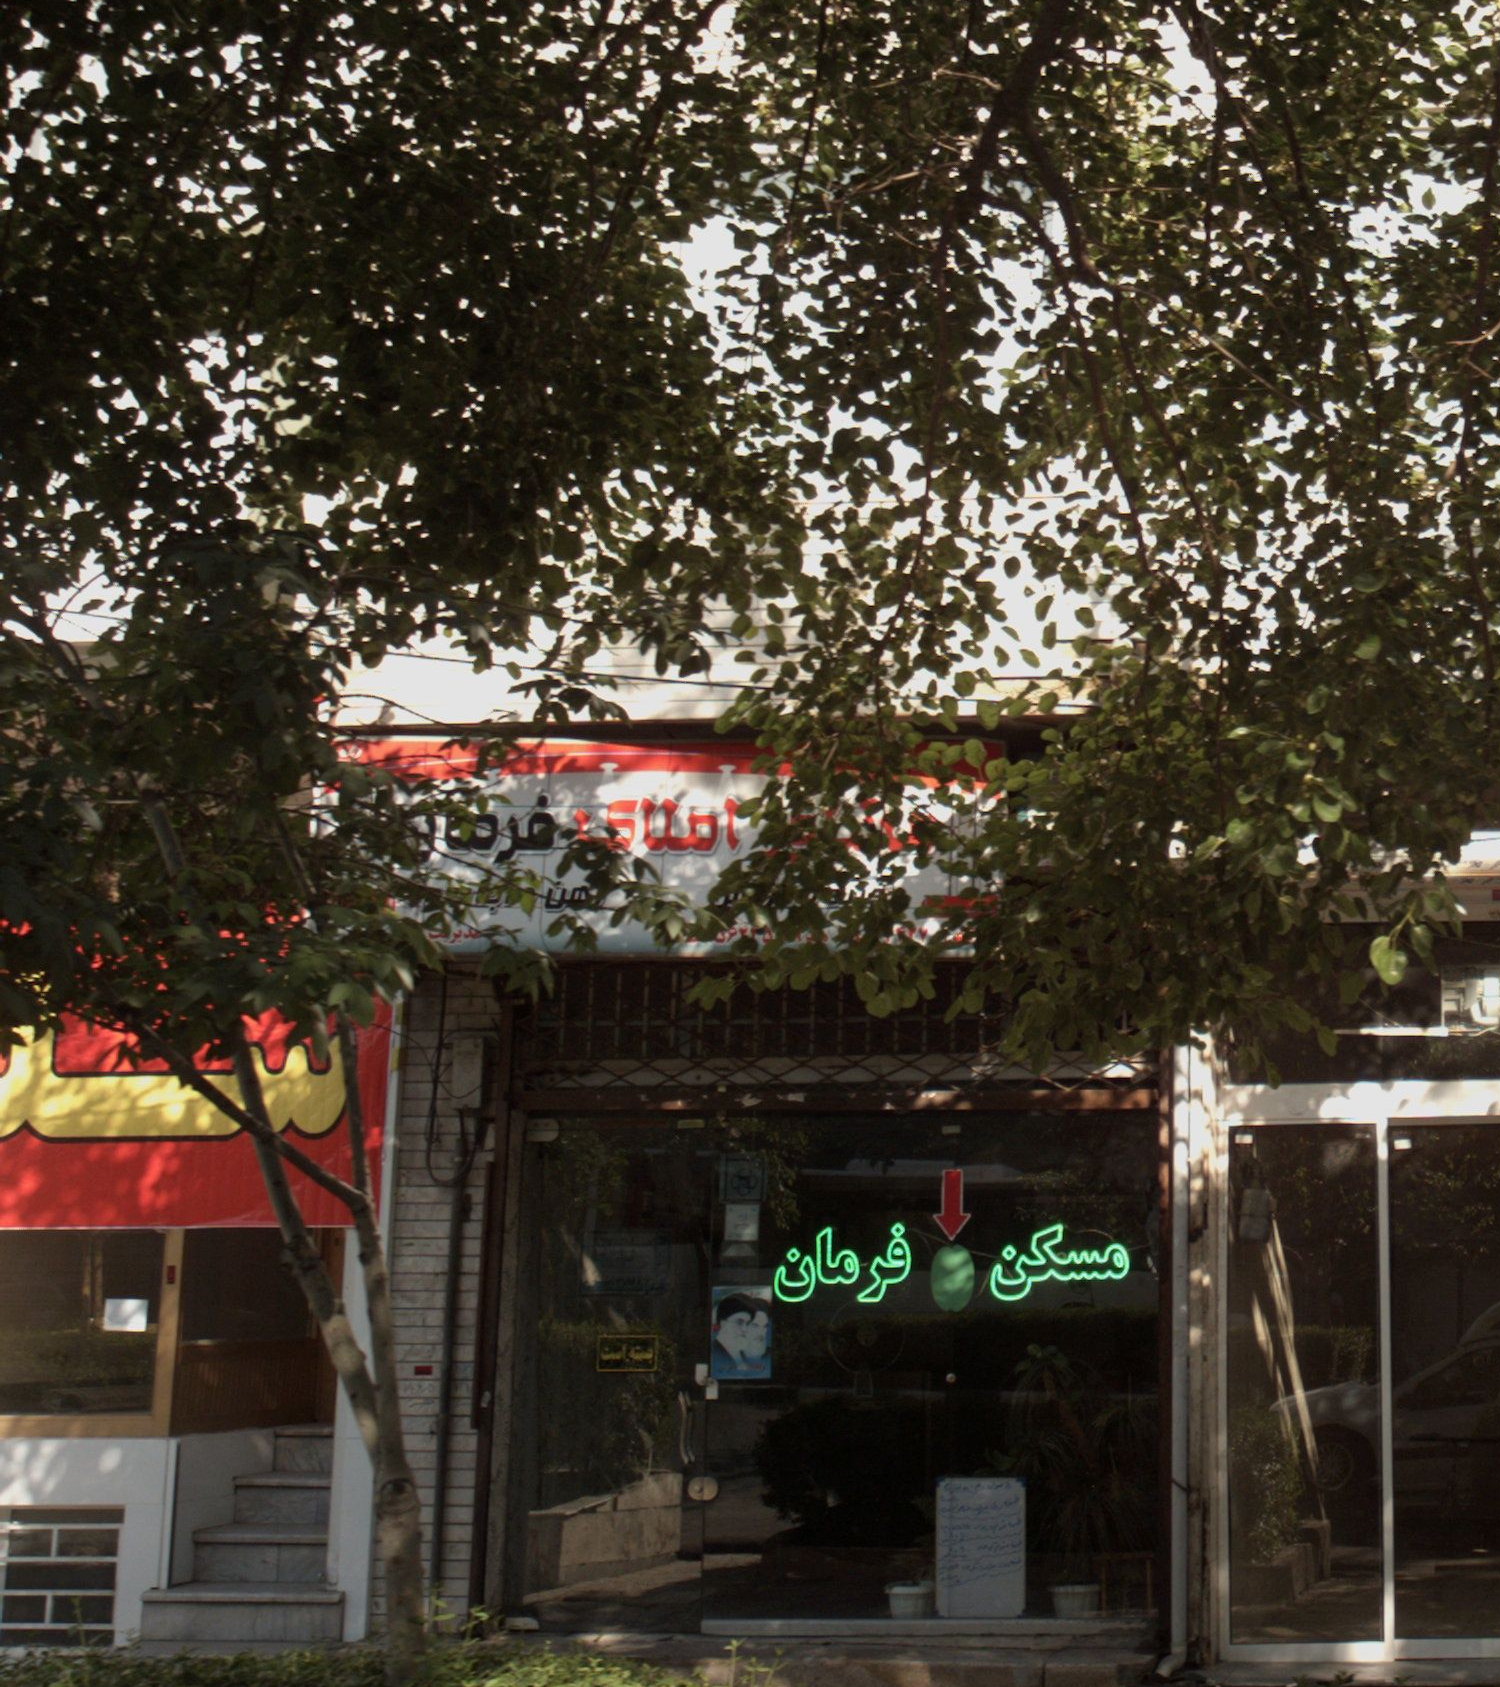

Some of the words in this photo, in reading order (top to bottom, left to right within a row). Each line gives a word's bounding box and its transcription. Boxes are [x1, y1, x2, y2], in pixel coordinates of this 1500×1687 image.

[408, 795, 555, 864] فرما
[773, 1222, 913, 1303] فرمان
[989, 1223, 1130, 1302] مسکن
